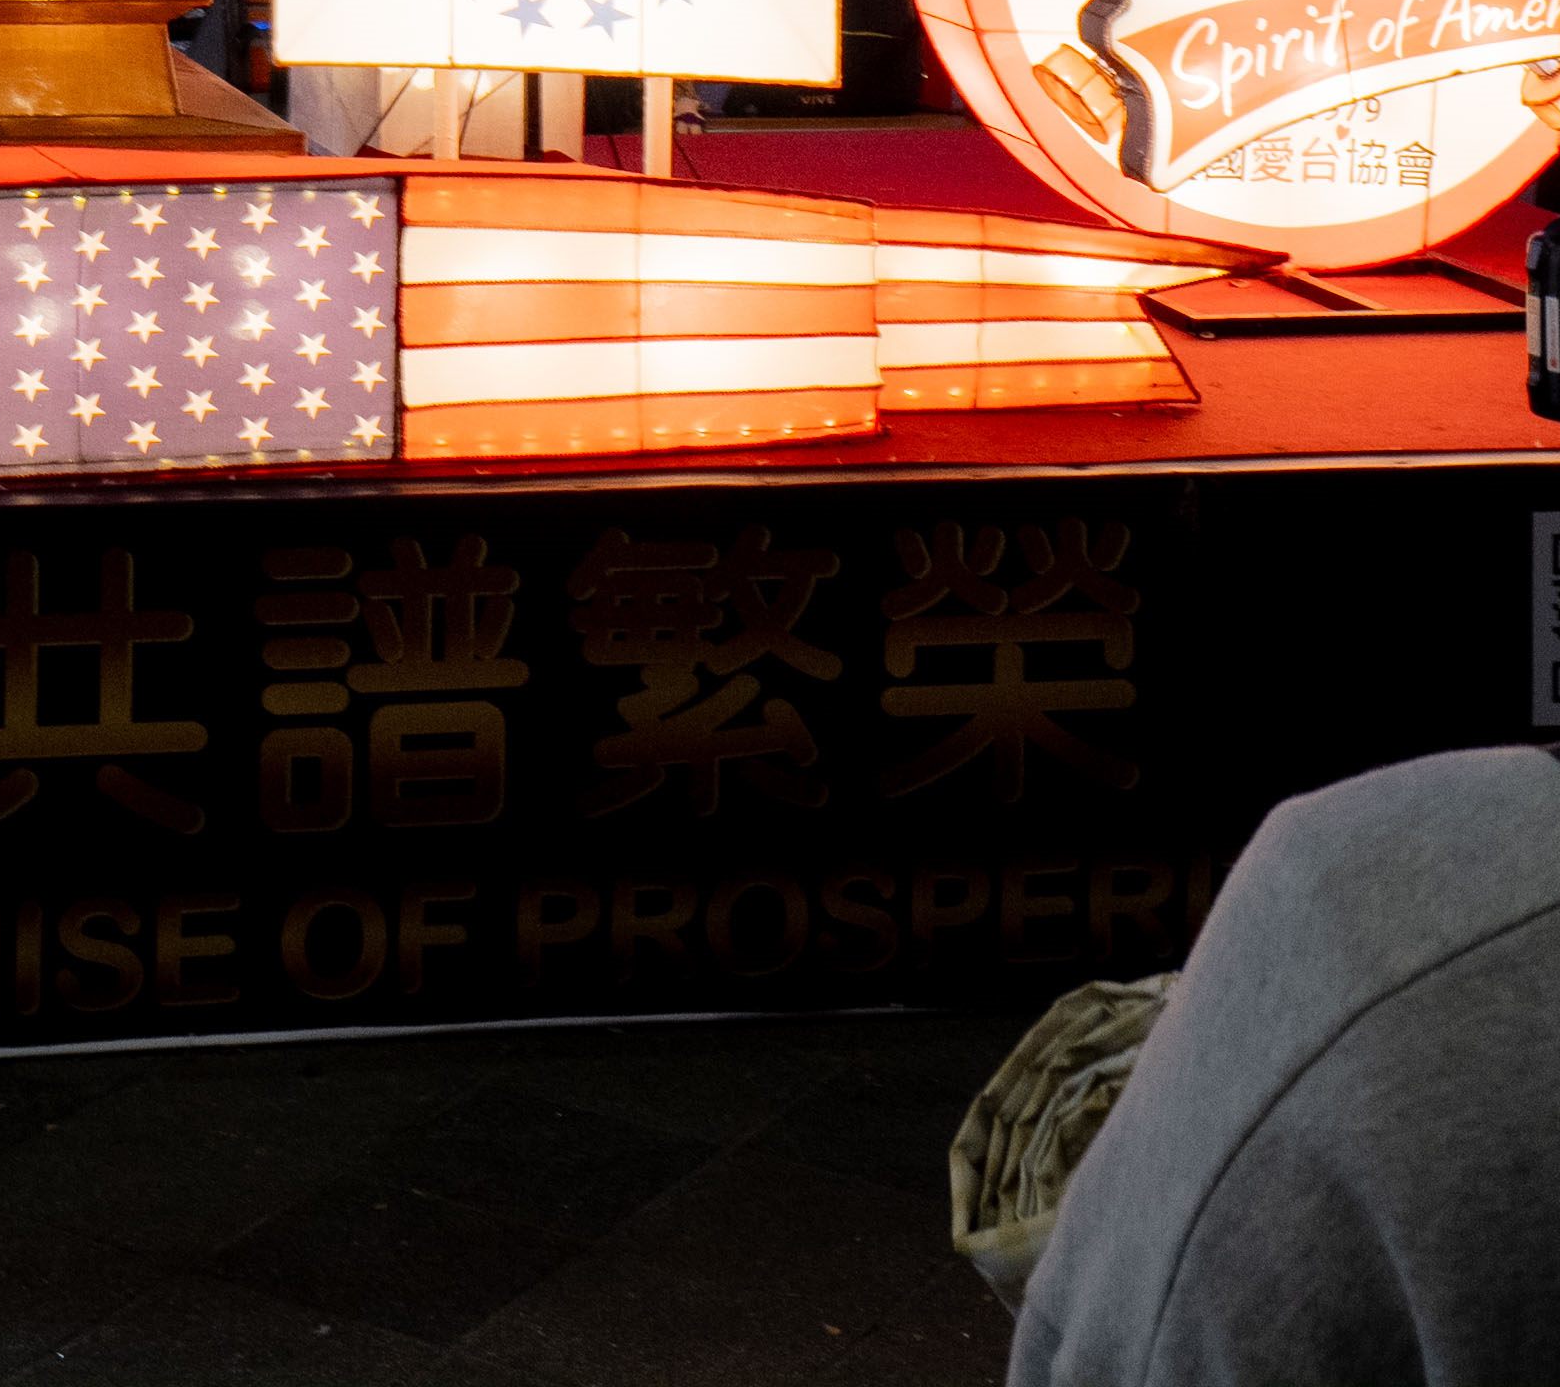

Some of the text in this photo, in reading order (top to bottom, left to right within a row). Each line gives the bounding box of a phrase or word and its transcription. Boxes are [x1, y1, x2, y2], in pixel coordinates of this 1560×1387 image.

[1188, 135, 1437, 188] 國愛台協會
[281, 877, 478, 1001] OF
